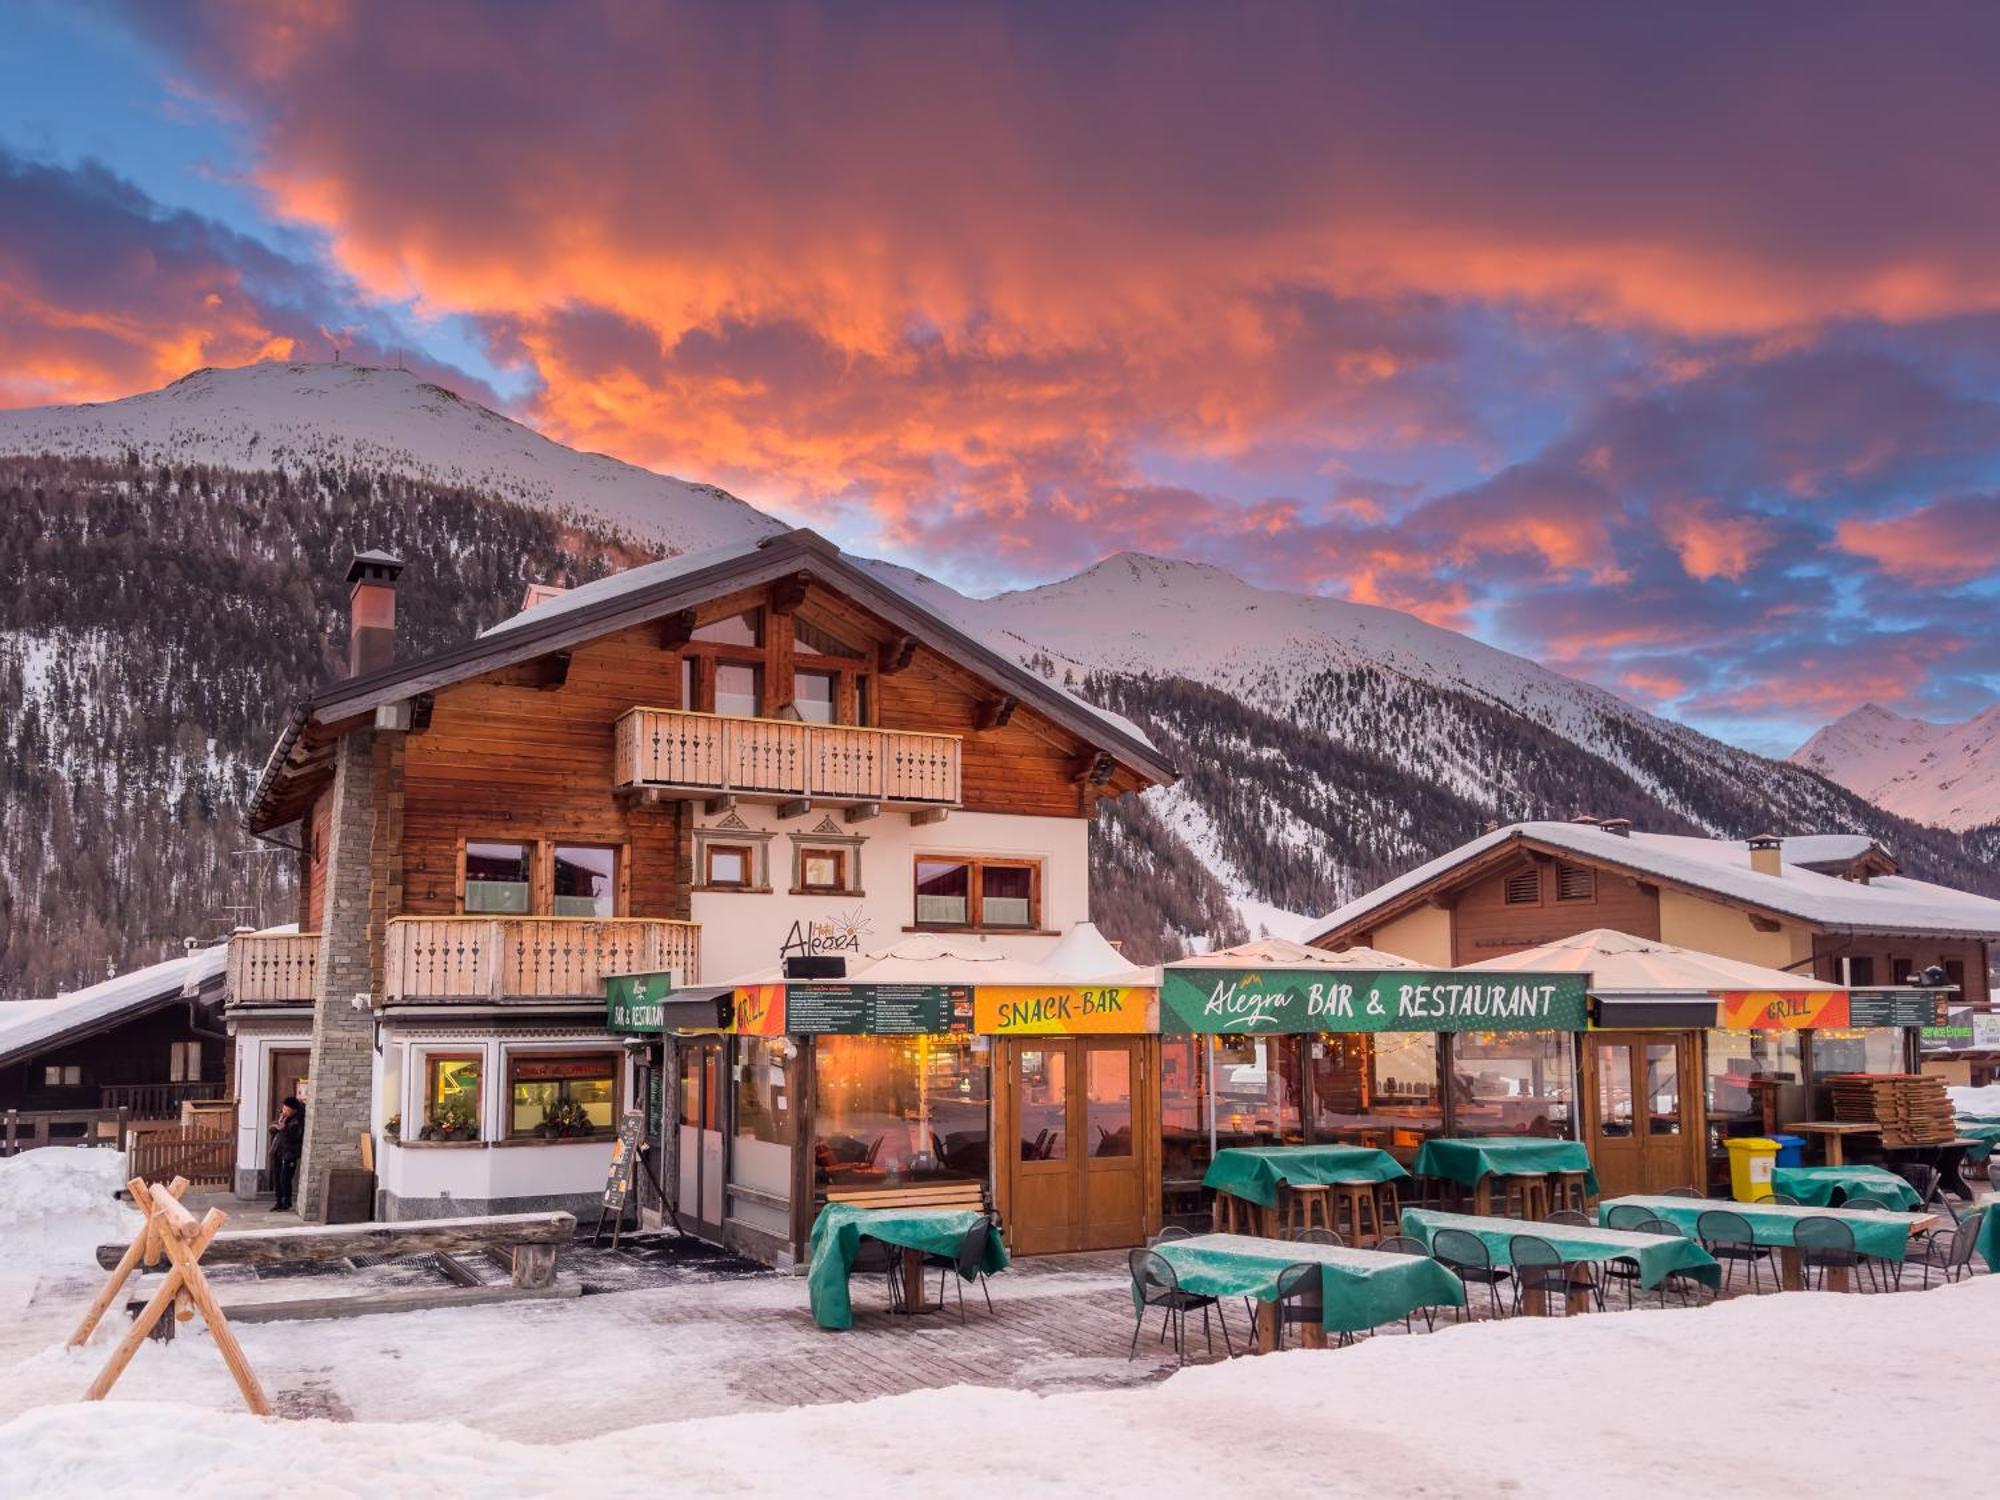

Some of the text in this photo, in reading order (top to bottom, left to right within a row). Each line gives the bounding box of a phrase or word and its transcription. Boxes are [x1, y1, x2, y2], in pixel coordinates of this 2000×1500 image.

[632, 1006, 665, 1026] RESTAURAN
[998, 988, 1122, 1028] SNACK-BAR
[1204, 979, 1556, 1027] Alegra BAR & RESTAURANT
[1767, 995, 1811, 1019] GRILL
